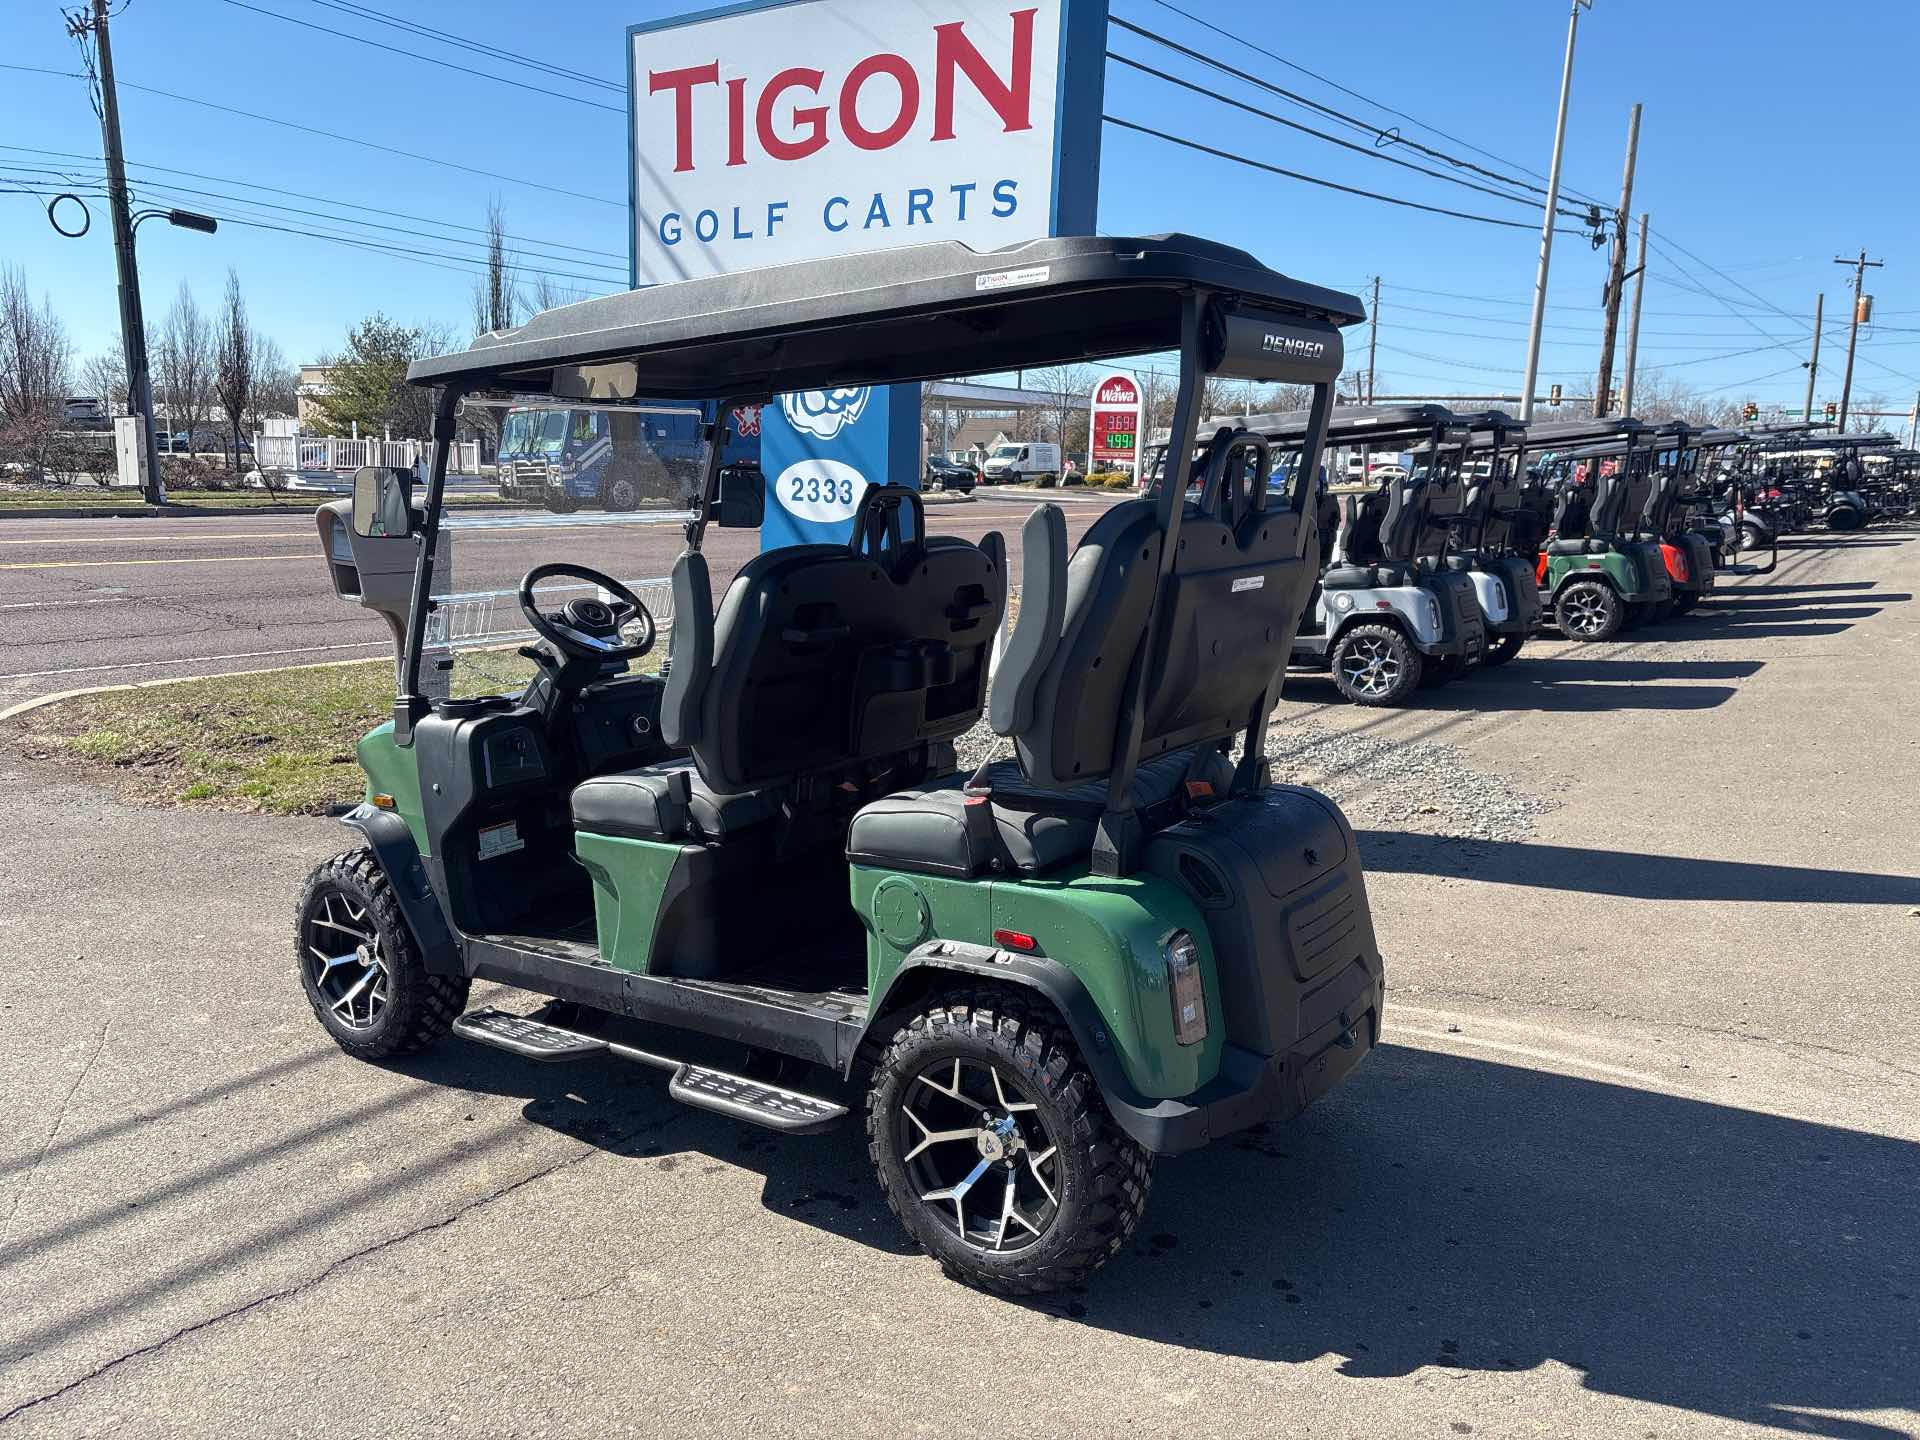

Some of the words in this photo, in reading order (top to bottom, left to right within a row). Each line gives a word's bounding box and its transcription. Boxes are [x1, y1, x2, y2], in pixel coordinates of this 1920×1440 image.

[649, 8, 1039, 173] TIGON
[659, 201, 789, 246] GOLF
[823, 179, 1018, 232] CARTS
[1263, 334, 1324, 358] DENAGO
[1101, 389, 1134, 402] Wawa
[791, 477, 853, 505] 2333
